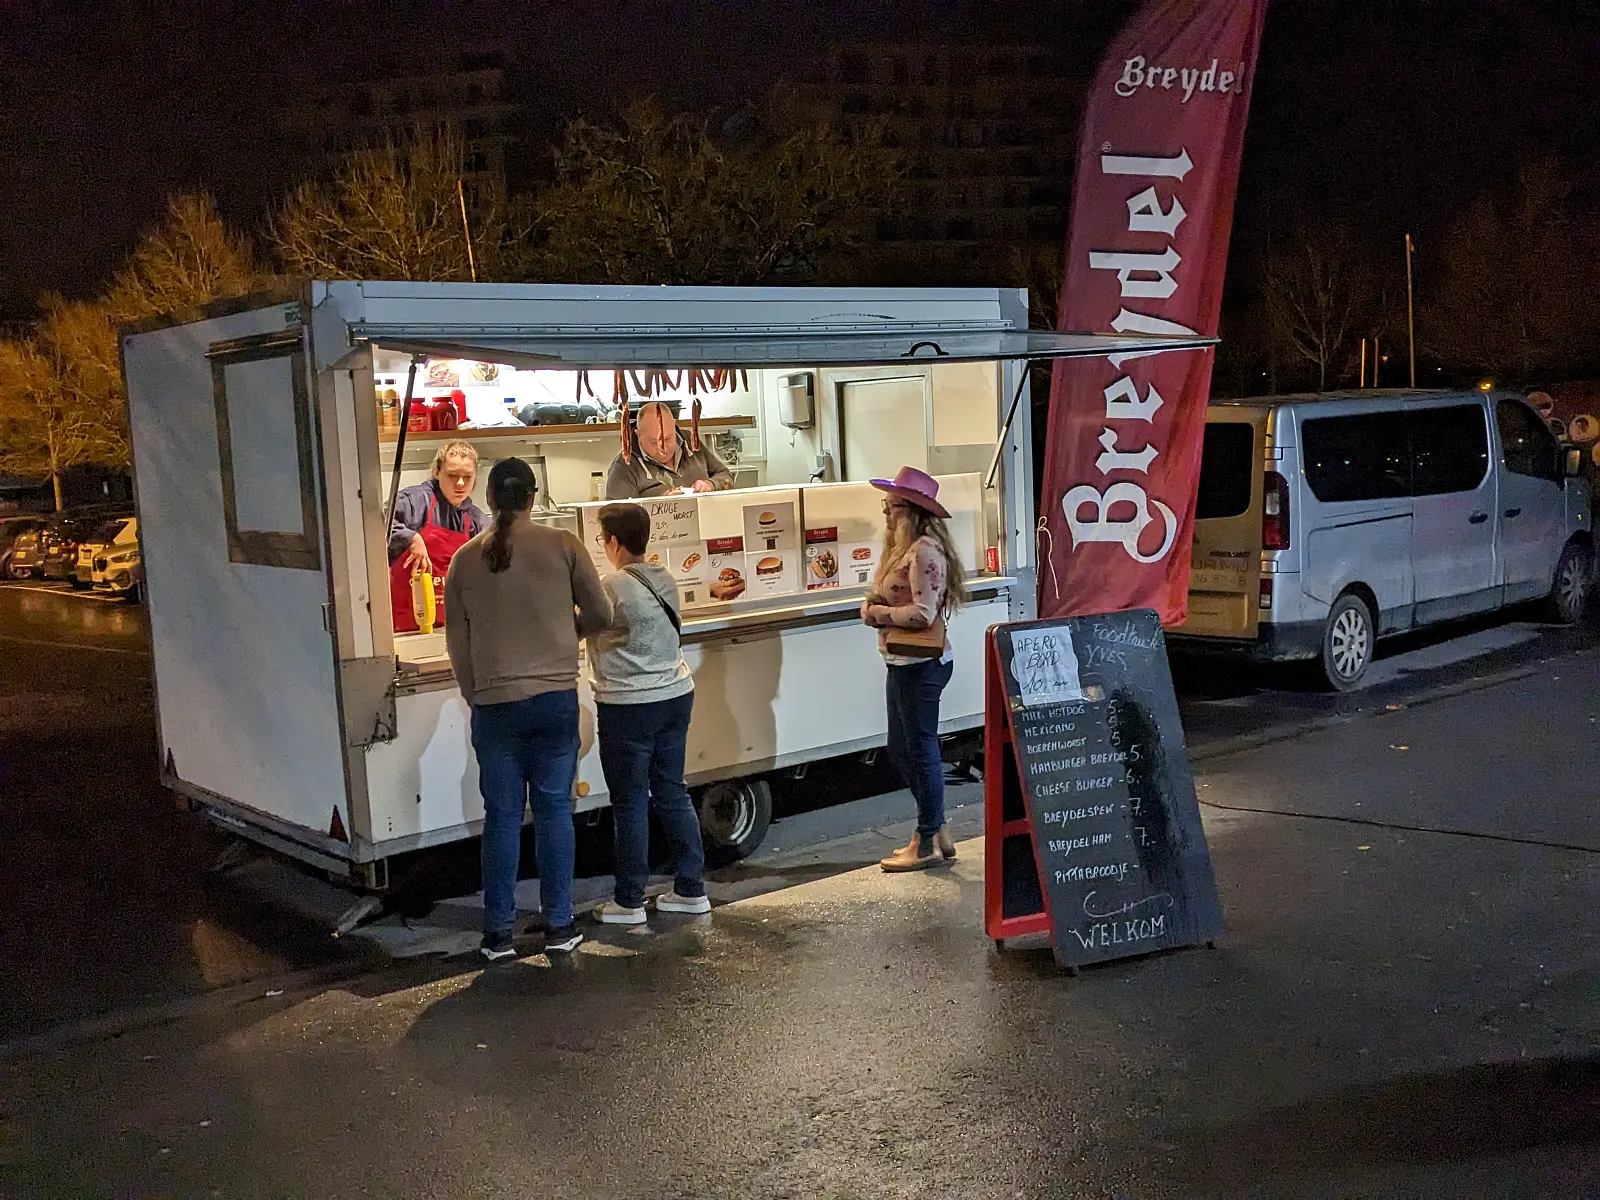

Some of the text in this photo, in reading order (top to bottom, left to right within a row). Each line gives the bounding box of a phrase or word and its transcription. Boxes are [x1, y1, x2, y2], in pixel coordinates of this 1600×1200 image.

[1114, 55, 1245, 103] Breydel
[1061, 146, 1207, 564] Breydel
[651, 502, 678, 516] DROGE
[673, 510, 695, 520] WORST
[1017, 635, 1057, 653] APERO
[1026, 650, 1061, 669] BORD
[1048, 705, 1085, 719] HOTDOG
[1026, 737, 1087, 755] BOERENWORST
[1030, 756, 1087, 775] HAMBURGER
[1090, 751, 1128, 765] BREYDEL
[1035, 780, 1071, 797] CHEESE
[1076, 776, 1113, 791] BURGER
[1092, 833, 1112, 845] HAM
[1068, 915, 1165, 949] WELKOM
